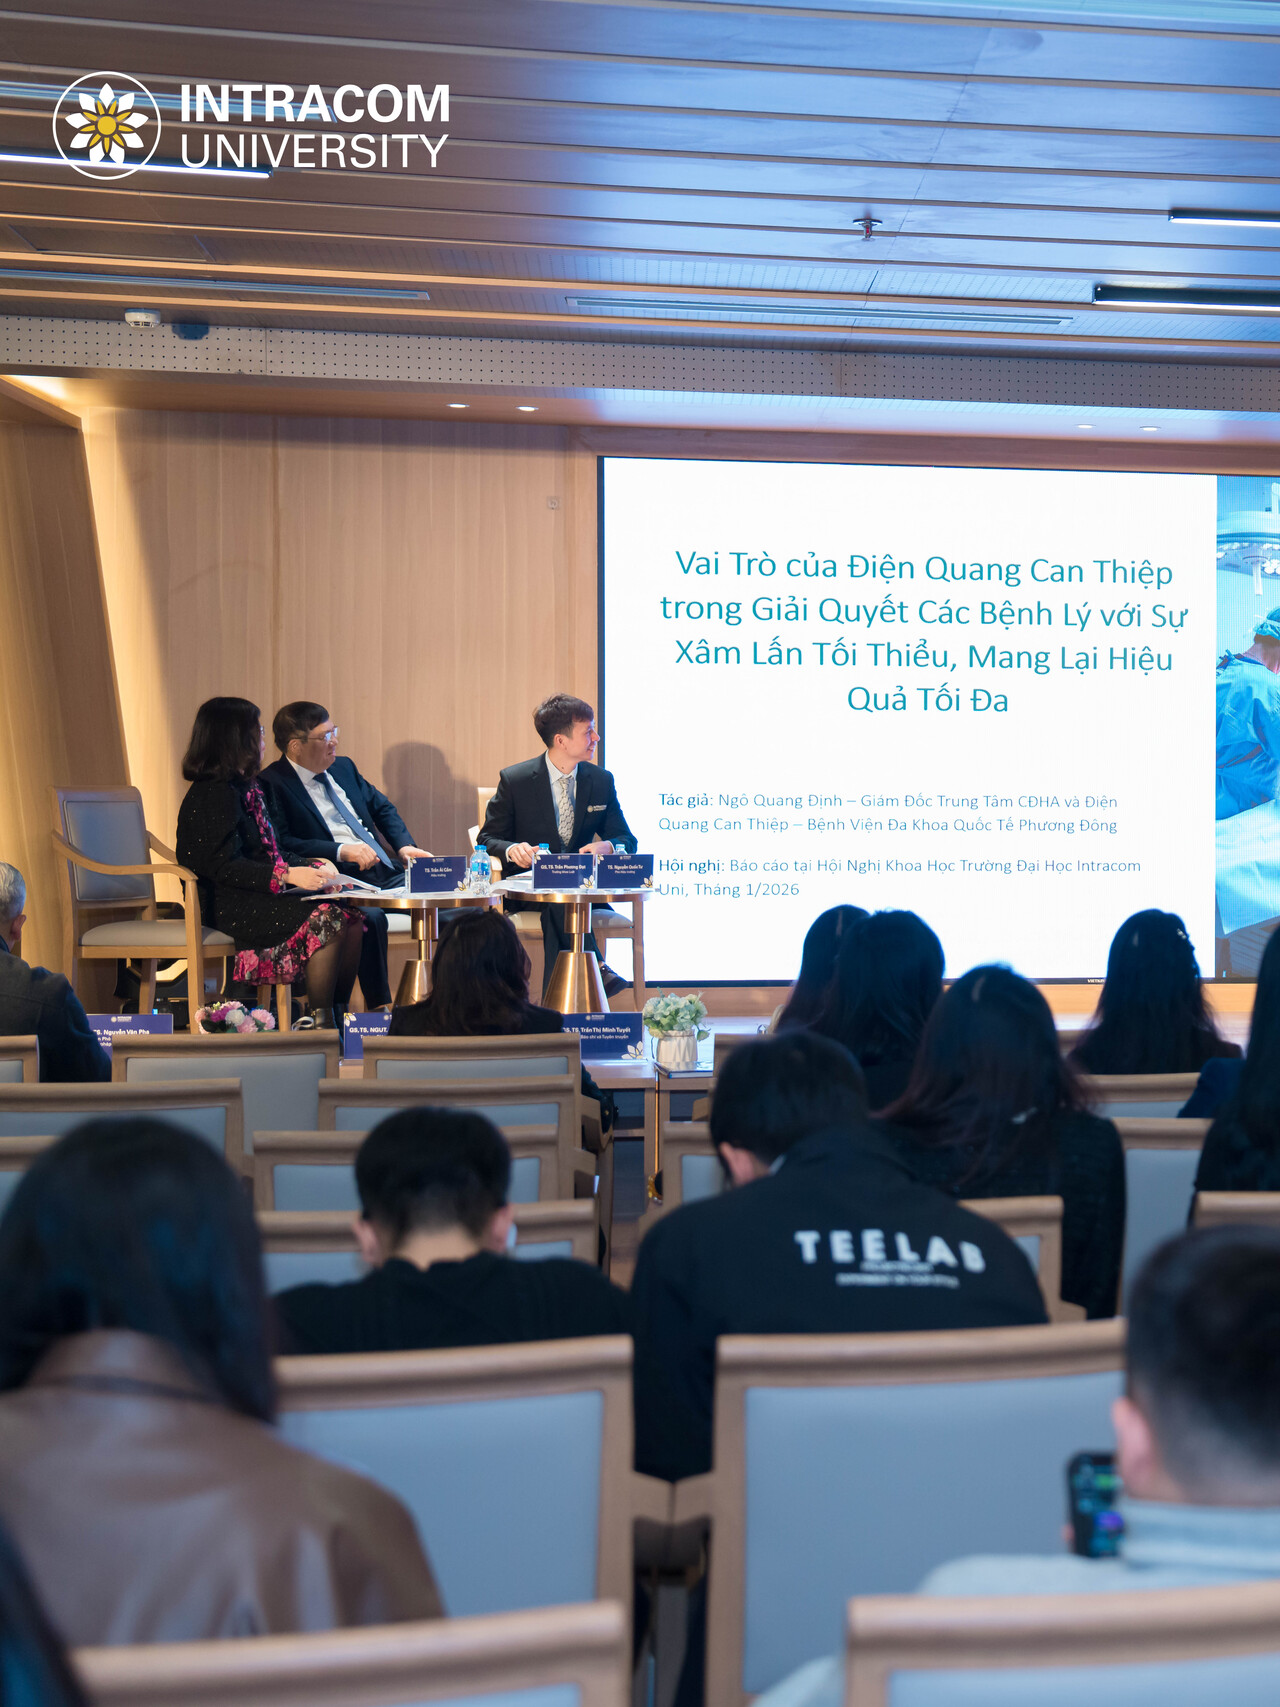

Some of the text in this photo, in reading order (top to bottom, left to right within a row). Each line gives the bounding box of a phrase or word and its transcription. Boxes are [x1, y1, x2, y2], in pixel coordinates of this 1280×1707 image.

[674, 550, 1173, 591] Vai Trò của Điện Quang Can Thiệp
[659, 593, 1189, 634] trong Giải Quyết Các Bệnh Lý với Sự
[675, 635, 1173, 677] Xâm Lấn Tối Thiểu, Mang Lại Hiệu
[847, 681, 1009, 714] Quả Tối Đa
[657, 792, 684, 807] Tác
[687, 792, 714, 809] giả:
[718, 792, 749, 810] Ngô
[753, 793, 804, 810] Quang
[807, 793, 843, 810] Định
[860, 794, 900, 808] Giám
[903, 792, 933, 808] Đốc
[936, 794, 979, 811] Trung
[982, 794, 1013, 808] Tâm
[1017, 795, 1061, 809] CĐHA
[1064, 795, 1080, 809] và
[1084, 794, 1118, 811] Điện
[658, 817, 709, 834] Quang
[713, 817, 742, 831] Can
[746, 817, 789, 833] Thiệp
[807, 817, 845, 834] Bệnh
[849, 817, 883, 834] Viện
[887, 818, 907, 831] Đa
[912, 818, 949, 832] Khoa
[953, 816, 992, 833] Quốc
[996, 816, 1015, 832] Tế
[1019, 818, 1076, 835] Phương
[1079, 818, 1118, 835] Đông
[659, 858, 1141, 875] Hội nghị: Báo cáo tại Hội Nghị Khoa Học Trường Đại Học Intracom
[658, 881, 800, 899] Uni, Tháng 1/2026
[793, 1227, 987, 1274] TEELAB
